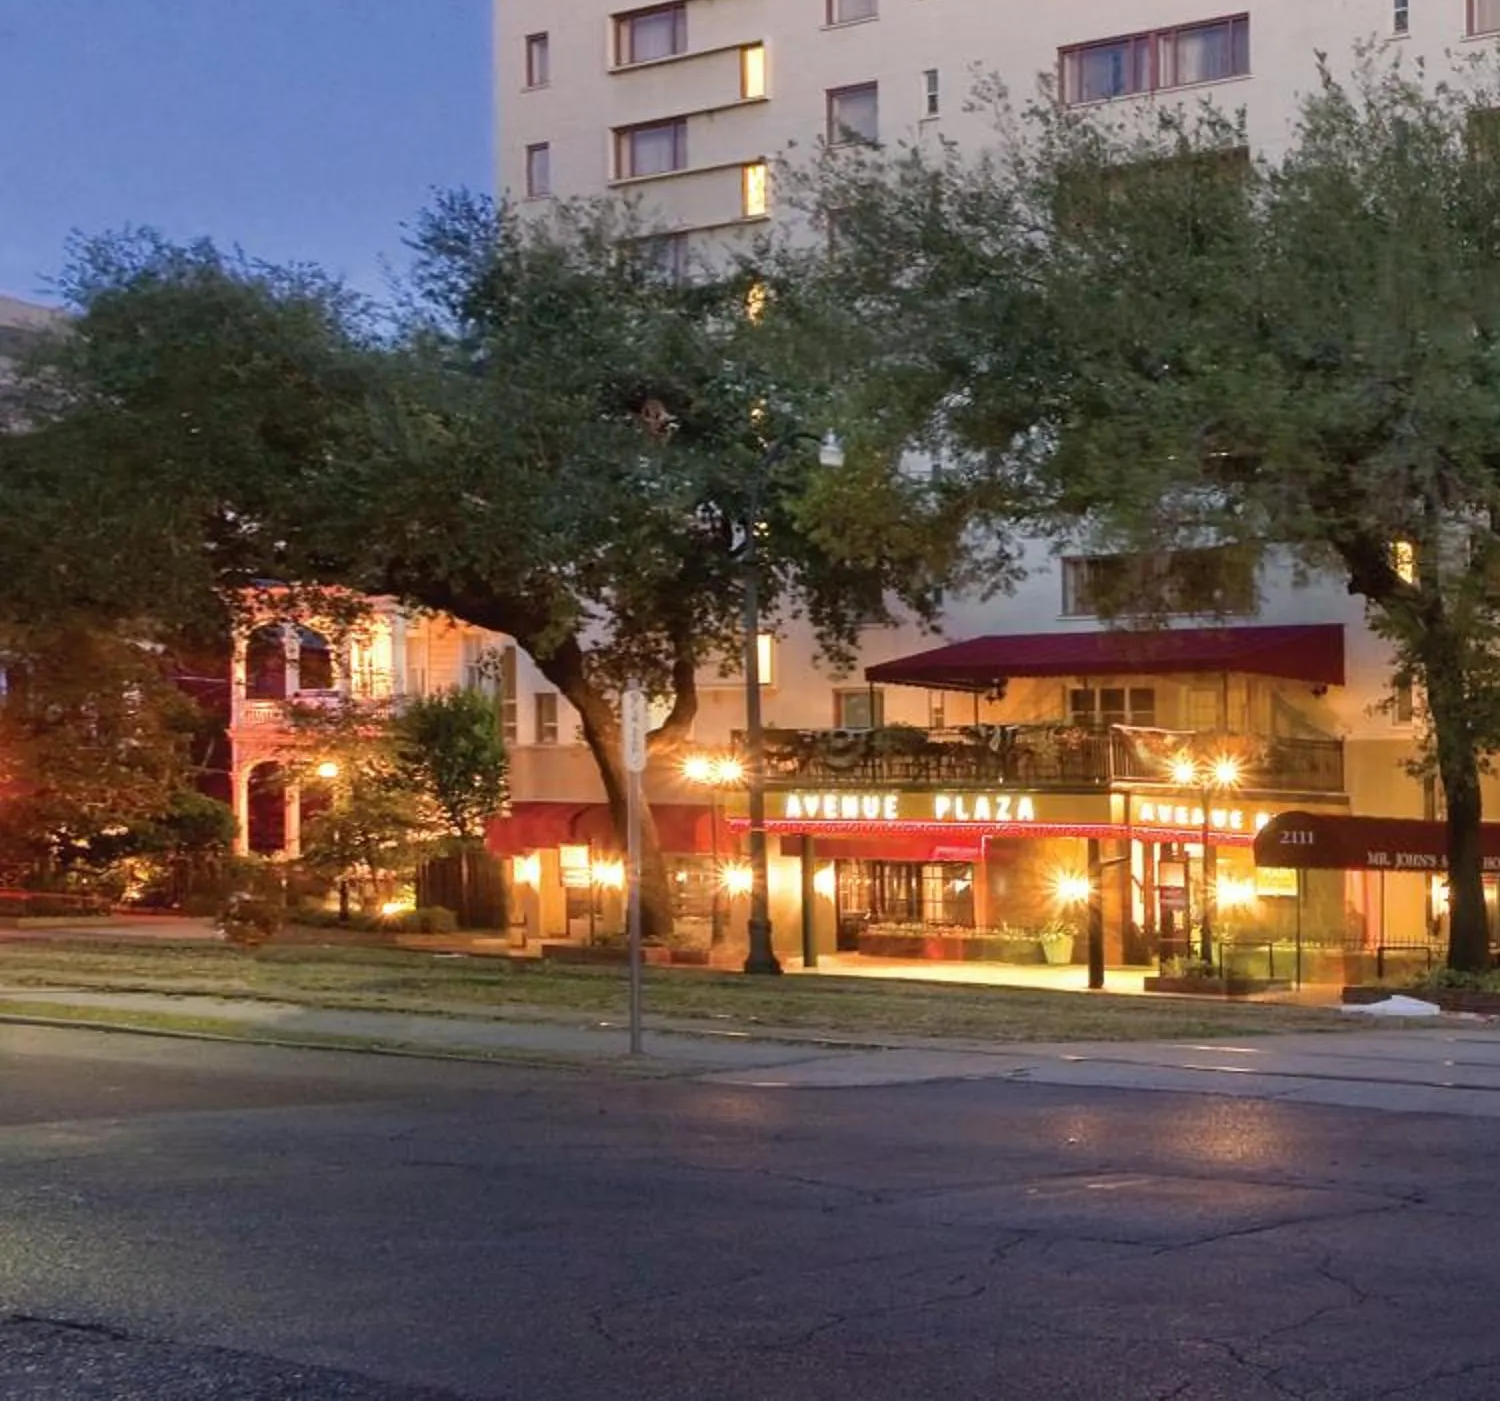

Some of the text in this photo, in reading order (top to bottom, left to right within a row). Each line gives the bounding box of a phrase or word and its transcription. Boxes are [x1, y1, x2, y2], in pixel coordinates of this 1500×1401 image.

[784, 793, 1034, 822] AVENUE PLAZA
[1139, 802, 1243, 830] AVENUE
[1279, 831, 1314, 845] 2111
[1367, 851, 1390, 866] MR.
